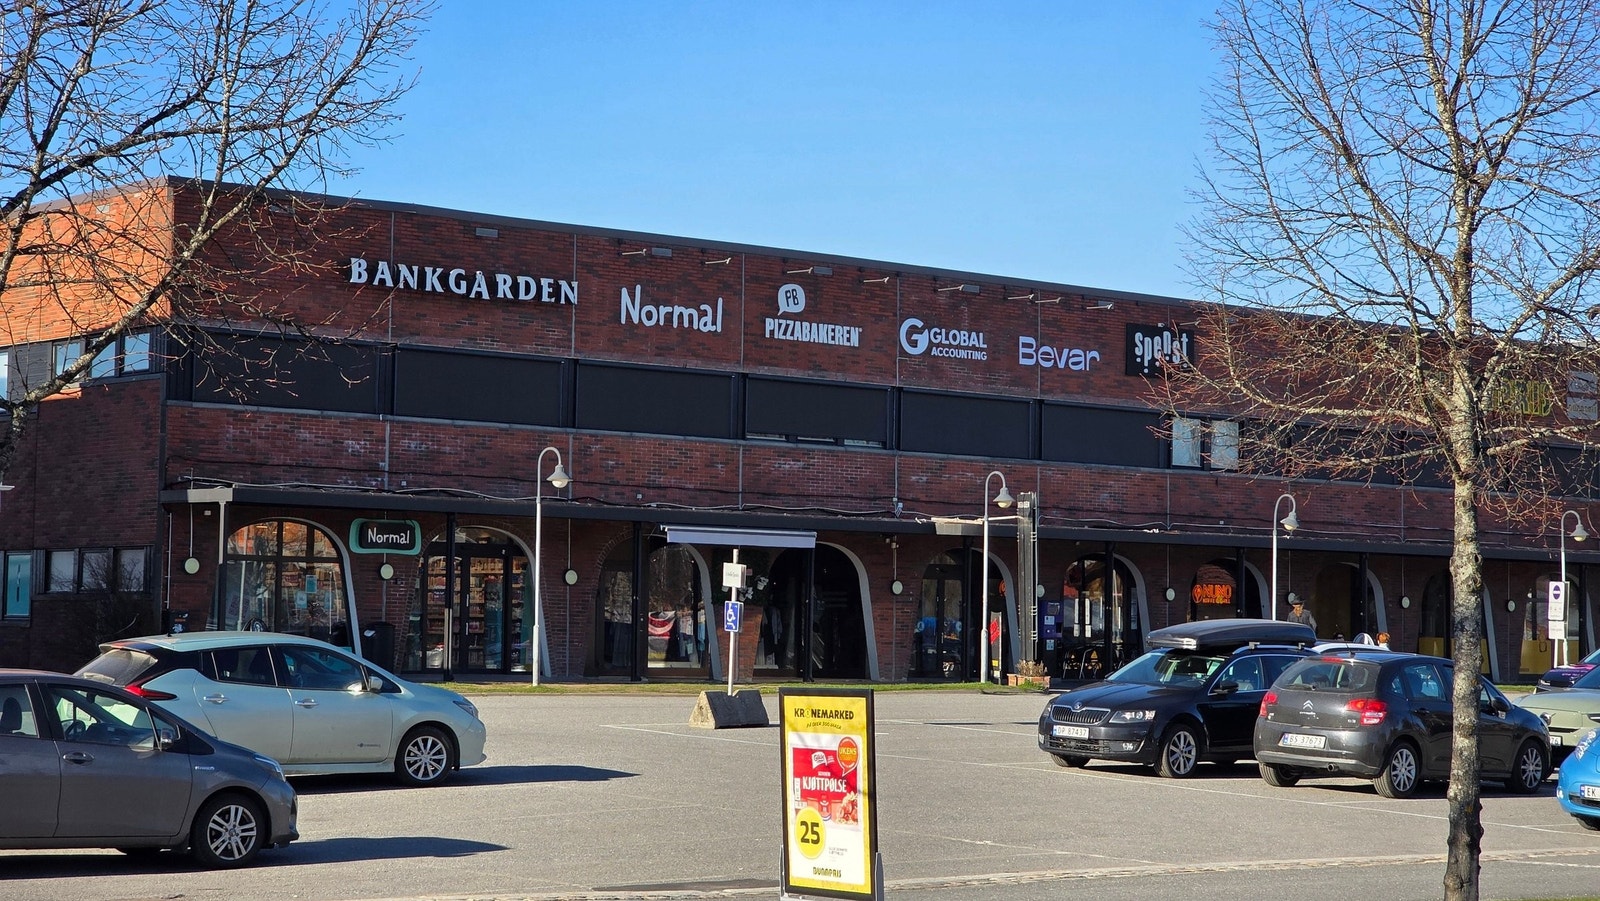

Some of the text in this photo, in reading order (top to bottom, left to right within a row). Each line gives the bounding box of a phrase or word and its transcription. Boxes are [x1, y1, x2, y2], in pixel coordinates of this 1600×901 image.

[784, 288, 800, 308] PB
[620, 284, 723, 333] Normal
[930, 327, 988, 349] GLOBAL
[931, 346, 988, 361] ACCOUNTING
[1018, 335, 1100, 371] Bevar
[367, 526, 410, 544] Normal
[1202, 584, 1232, 599] NUNO
[1067, 727, 1087, 737] 87437
[802, 776, 847, 793] KJØTTPØLSE
[1586, 787, 1596, 798] EK
[800, 820, 821, 845] 25
